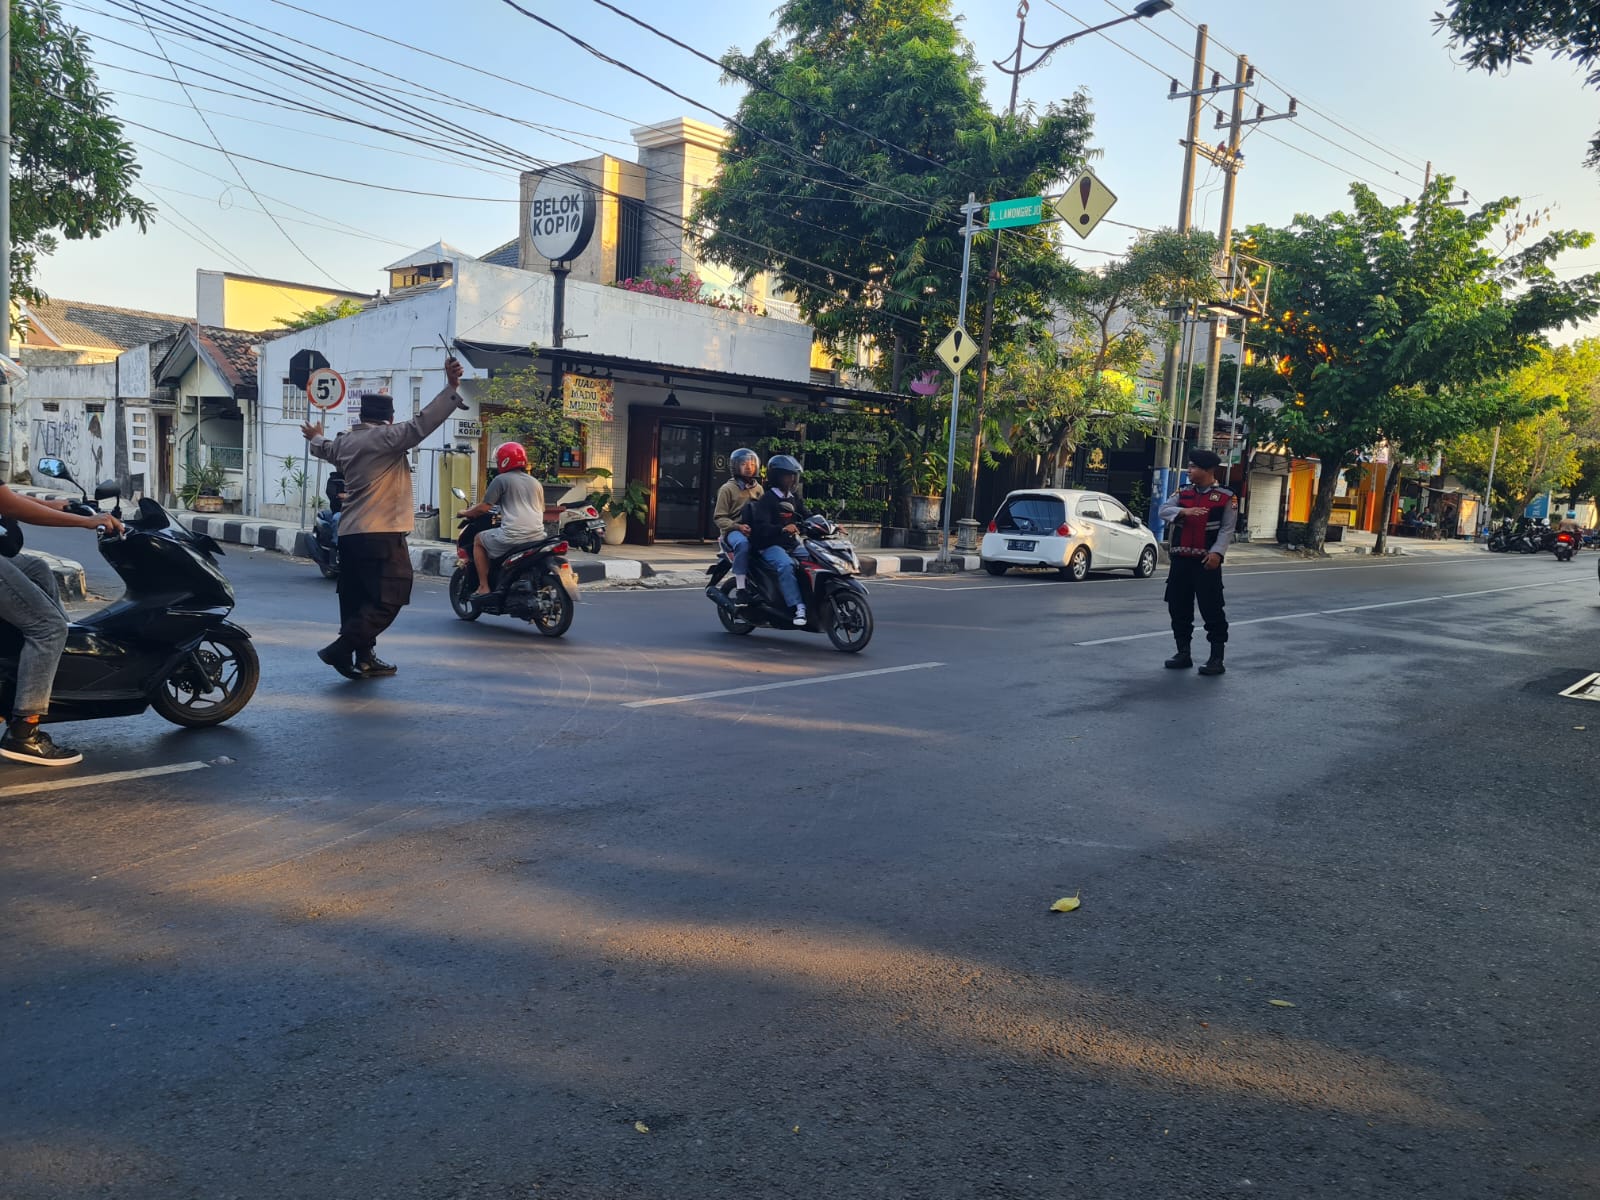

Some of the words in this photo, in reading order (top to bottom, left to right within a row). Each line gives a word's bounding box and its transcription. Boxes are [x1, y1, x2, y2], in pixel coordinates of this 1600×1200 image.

[533, 193, 580, 217] BELOK
[533, 215, 570, 237] KOPI
[575, 378, 595, 388] JUAL
[571, 389, 597, 400] MADU
[458, 421, 478, 429] BELO
